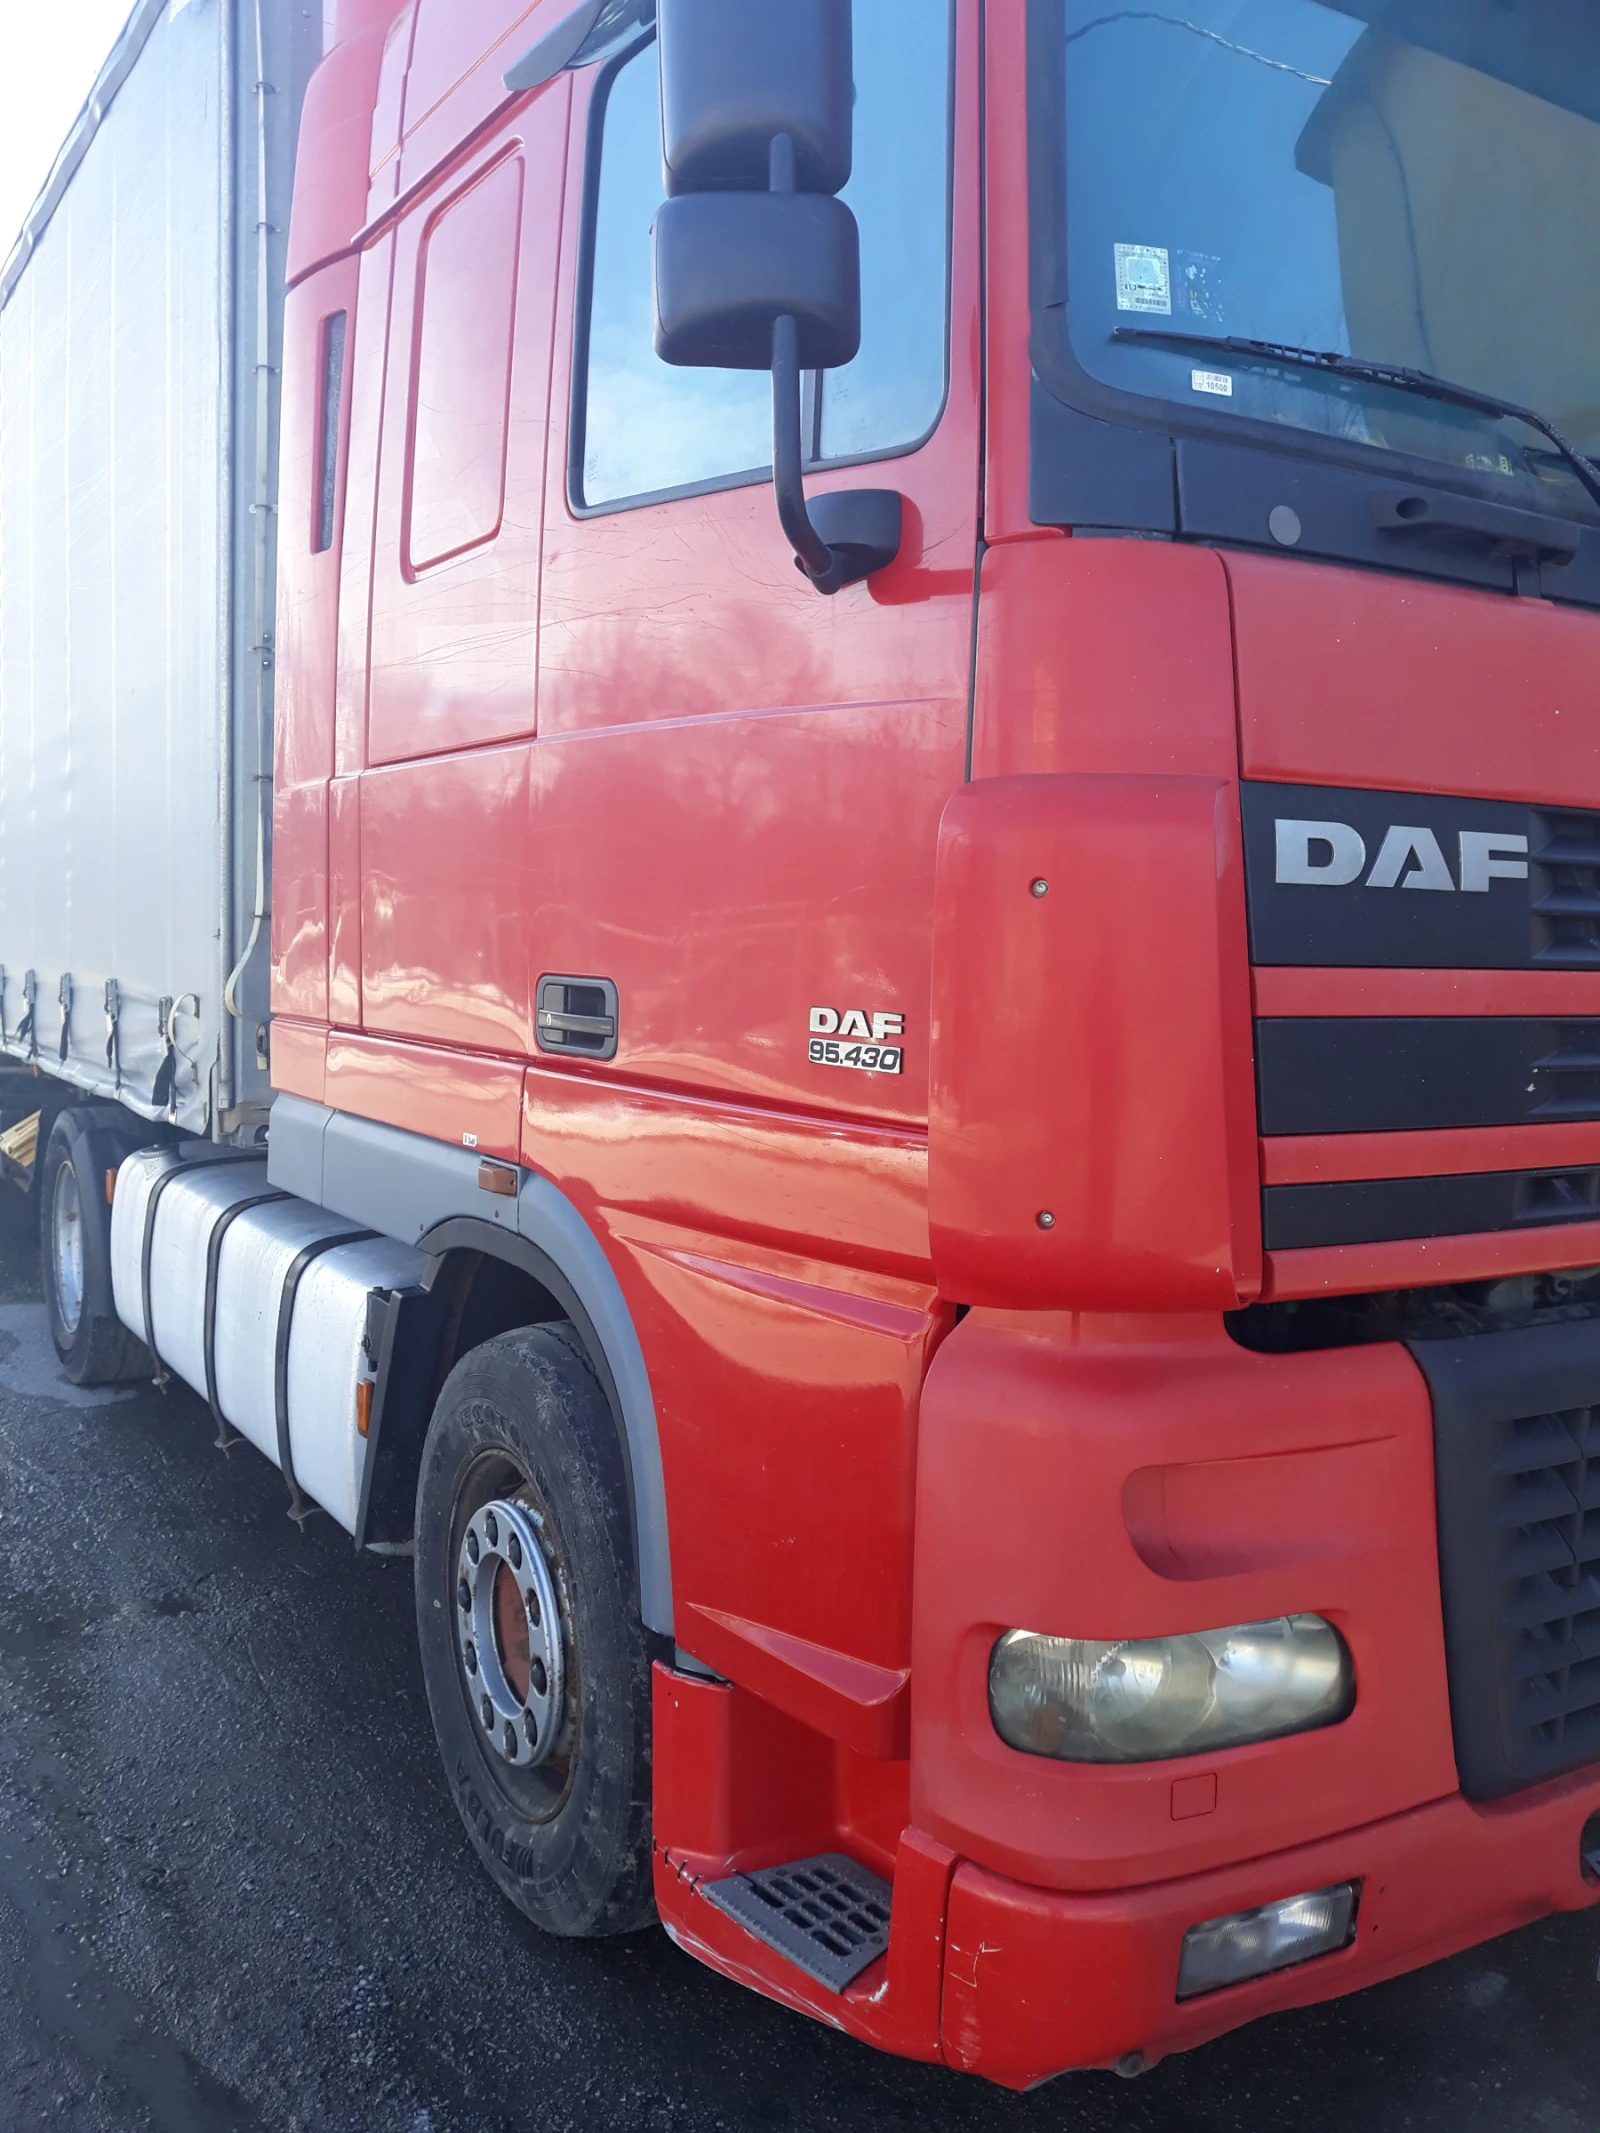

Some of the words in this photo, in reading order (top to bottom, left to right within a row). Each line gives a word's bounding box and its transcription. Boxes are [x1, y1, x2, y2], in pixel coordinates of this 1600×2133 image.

[1275, 818, 1529, 893] DAF
[809, 1006, 904, 1039] DAF
[809, 1040, 900, 1071] 95.430
